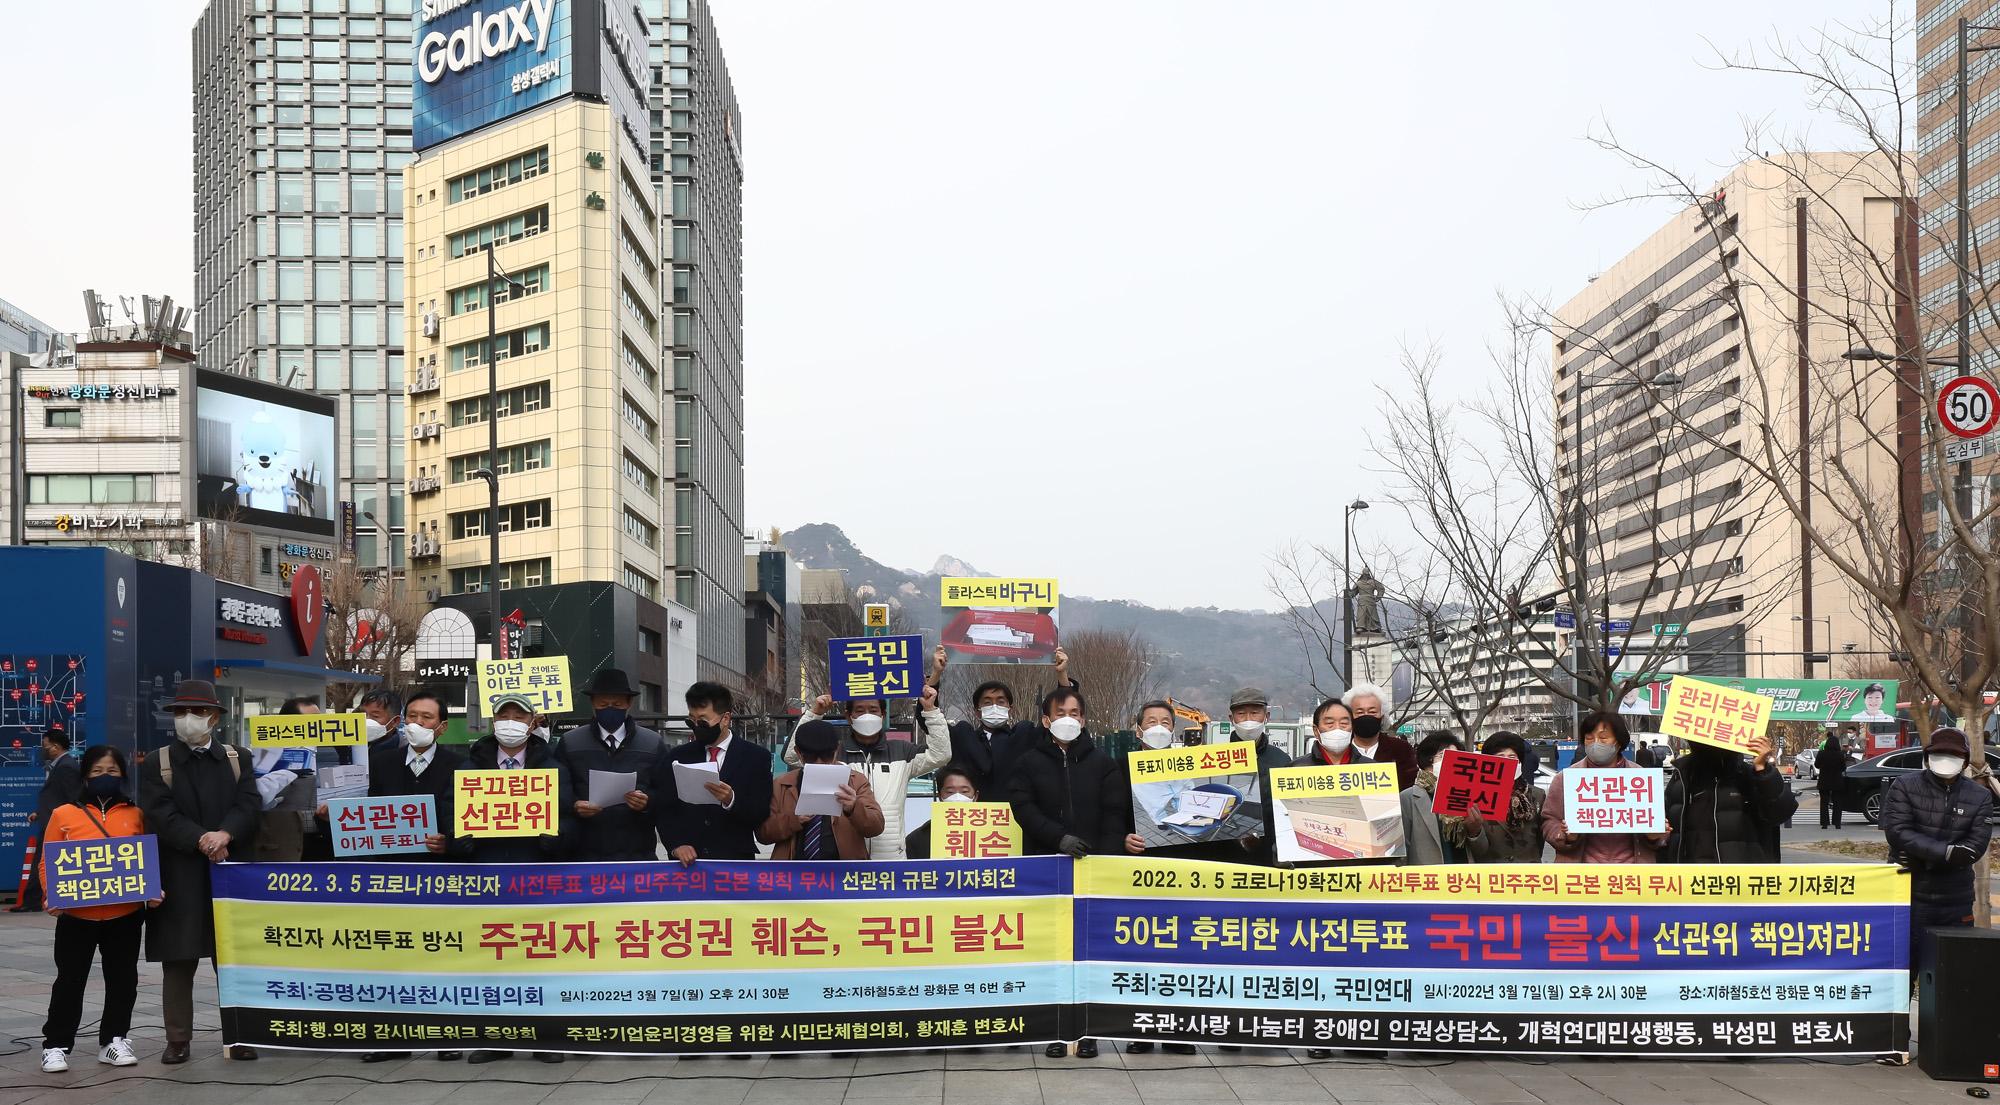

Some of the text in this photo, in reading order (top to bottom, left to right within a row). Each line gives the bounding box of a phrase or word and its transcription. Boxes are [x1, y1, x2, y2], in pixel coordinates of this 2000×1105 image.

[418, 0, 556, 83] Galaxy
[511, 58, 560, 93] 삼성갤럭시
[1951, 392, 1987, 422] 50
[1946, 441, 1981, 458] 도심부
[948, 582, 1051, 602] 플라스틱 바구니
[510, 630, 521, 658] 마녀김
[843, 640, 908, 667] 국민
[419, 663, 470, 677] 마녀김밥
[486, 662, 560, 675] 50년 전에도
[487, 674, 562, 691] 이런 투표
[845, 670, 910, 697] 불신
[1679, 685, 1761, 724] 관리부실
[1772, 700, 1796, 712] 레기
[1796, 700, 1819, 713] 정치
[256, 718, 359, 743] 플라스틱 바구니
[1673, 710, 1755, 748] 국민불신
[1136, 748, 1248, 775] 투표지 이송용 쇼핑백
[1453, 757, 1505, 785] 국민
[461, 775, 552, 798] 부끄럽다
[1277, 771, 1392, 792] 투표지 이송용 종이박스
[1575, 776, 1653, 803] 선관위
[1446, 787, 1499, 815] 불신
[337, 802, 429, 831] 선관위
[461, 801, 551, 831] 선관위
[945, 808, 1010, 826] 참정권
[1576, 808, 1655, 828] 책임져라
[340, 835, 374, 851] 이게
[945, 831, 1011, 857] 훼손
[1324, 825, 1344, 837] 소포
[54, 842, 144, 876] 선관위
[56, 874, 146, 901] 책임져라
[267, 868, 1016, 896] 2022. 3. 5 코로나19확진자 사전투표 방식 민주주의 근본 원칙 무시 선관위 규탄 기자회견
[1132, 870, 1855, 895] 2022. 3. 5 코로나19확진자 사전투표 방식 민주주의 근본 원칙 무시 선관위 규탄 기자회견
[264, 912, 1025, 960] 확진자 사전투표 방식 주권자 참정권 훼손, 국민 불신
[1114, 913, 1871, 962] 50년 후퇴한 사전투표 국민 불신 선관위 책임져라!
[266, 980, 1026, 1006] 주최:공명선거실천시민협의회 일시:2022년 3월 7일(월) 오후 2시 30분 장소:지하철5호선 광화문 역 6번 출구
[1111, 972, 1872, 1003] 주최:공익감시 민권회의, 국민연대 일시:2022년 3월 7일(월) 오후 2시 30분 장소:지하철5호선 광화문 역 6번 출구
[269, 1020, 367, 1039] 주최:행.의정
[373, 1023, 479, 1040] 감시네트워크
[566, 1025, 733, 1043] 주관:기업윤리경영을
[739, 1024, 775, 1042] 위한
[780, 1021, 910, 1041] 시민단체협의회,
[916, 1019, 968, 1038] 황재훈
[974, 1016, 1025, 1035] 변호사
[1132, 1013, 1854, 1045] 주관:사랑 나눔터 장애인 인권상담소, 개혁연대민생행동, 박성민 변호사
